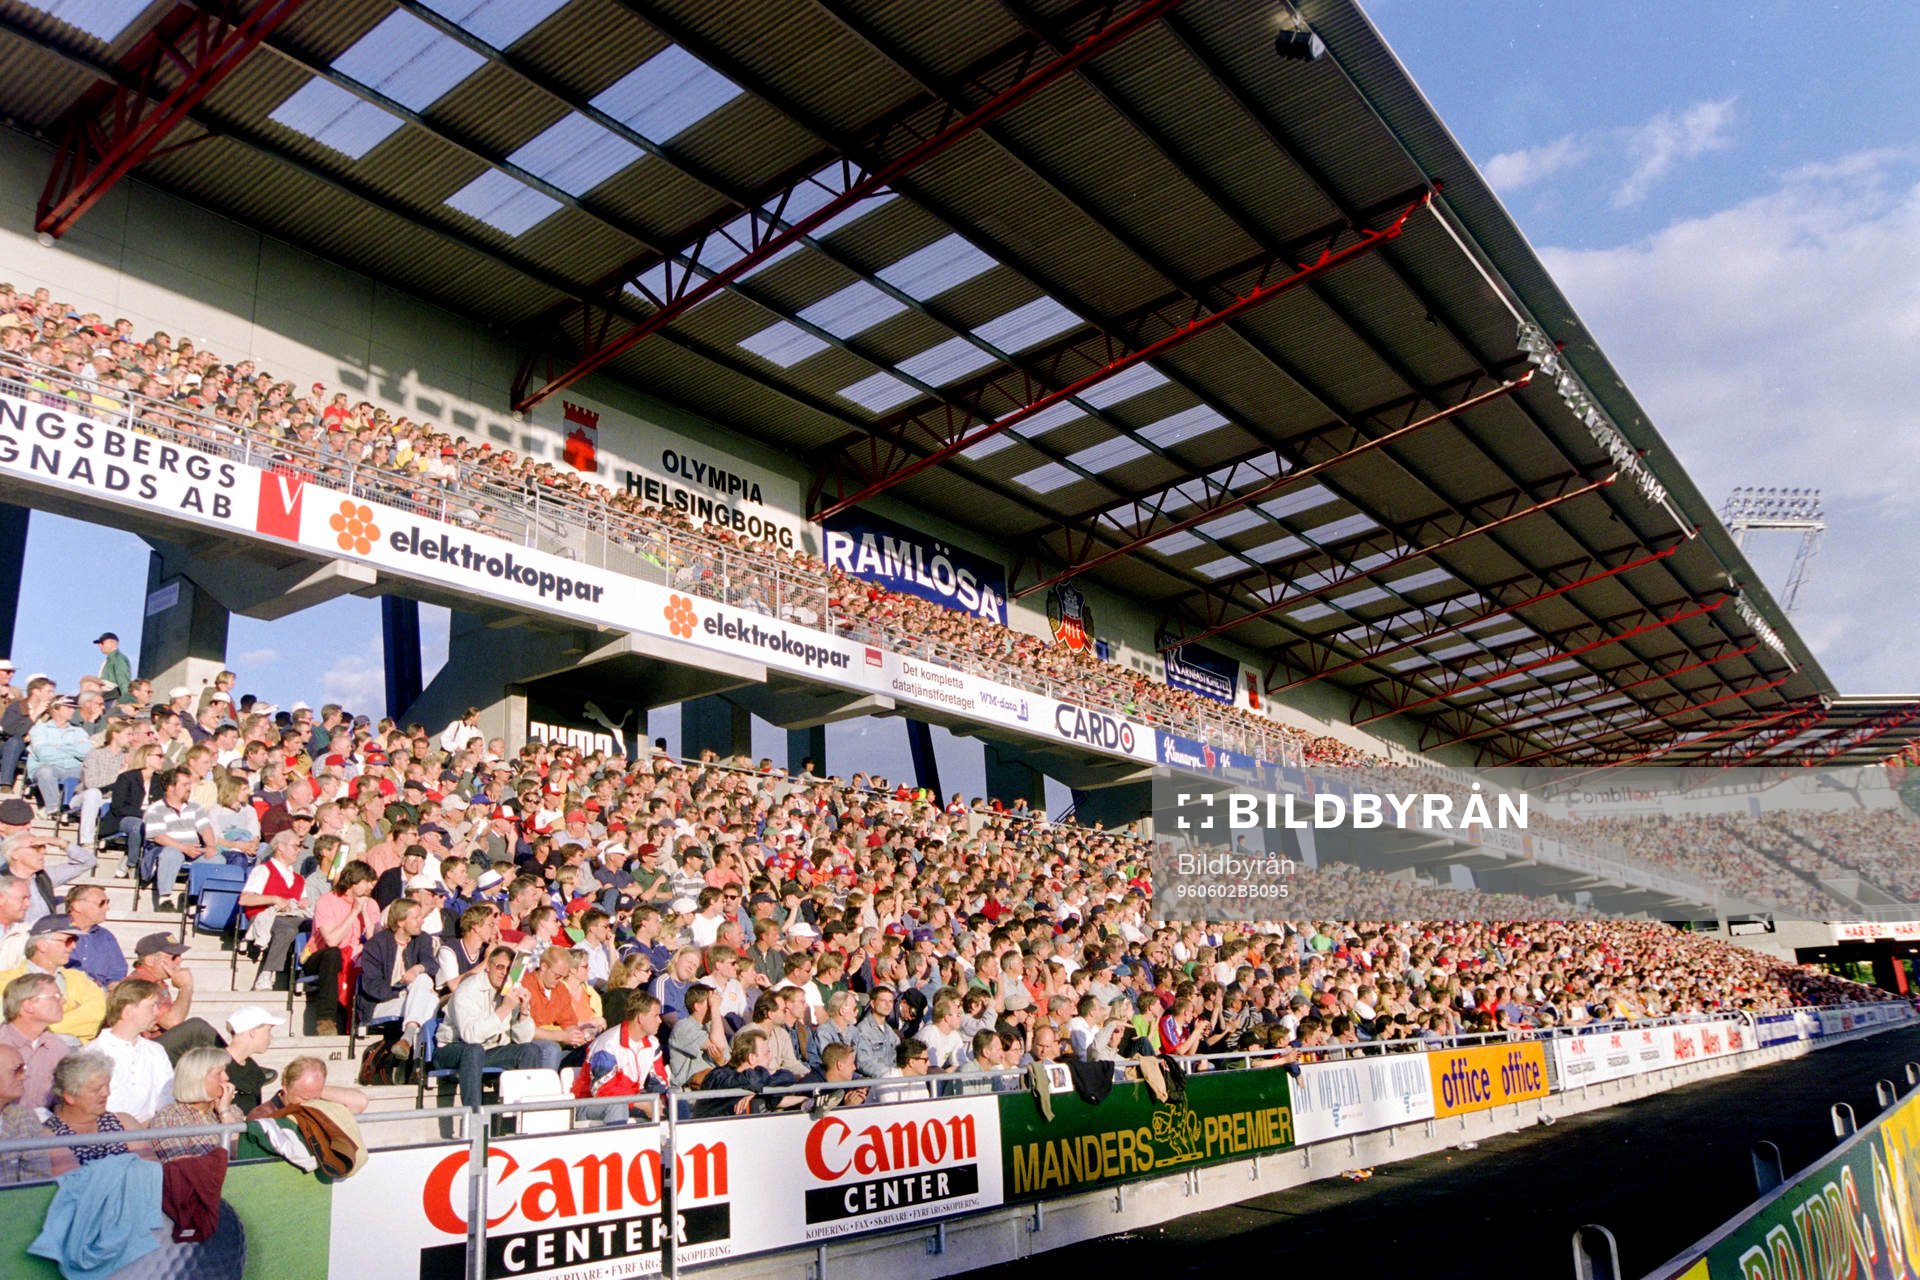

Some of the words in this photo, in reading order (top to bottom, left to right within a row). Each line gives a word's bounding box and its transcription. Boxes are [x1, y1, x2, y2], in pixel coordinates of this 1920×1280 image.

[180, 486, 232, 519] AB
[662, 449, 763, 506] OLYMPIA
[625, 470, 794, 550] HELSINGBORG
[389, 526, 604, 603] elektrokoppar
[826, 530, 1001, 625] RAMLÖSA
[703, 612, 850, 669] elektrokoppar
[892, 678, 976, 711] datatjänstföretaget
[902, 662, 919, 676] Det
[920, 667, 964, 689] kompletta
[1055, 702, 1135, 754] CARDO
[1441, 1057, 1492, 1109] office
[1501, 1051, 1542, 1096] office
[805, 1113, 977, 1181] Canon
[1013, 1125, 1155, 1195] MANDERS
[1204, 1106, 1294, 1157] PREMIER
[422, 1140, 729, 1235] Canon
[843, 1172, 950, 1214] CENTER
[503, 1213, 688, 1272] CENTER
[805, 1224, 850, 1240] KOPIERING
[854, 1219, 870, 1232] FAX
[872, 1212, 909, 1227] SKRIVARE
